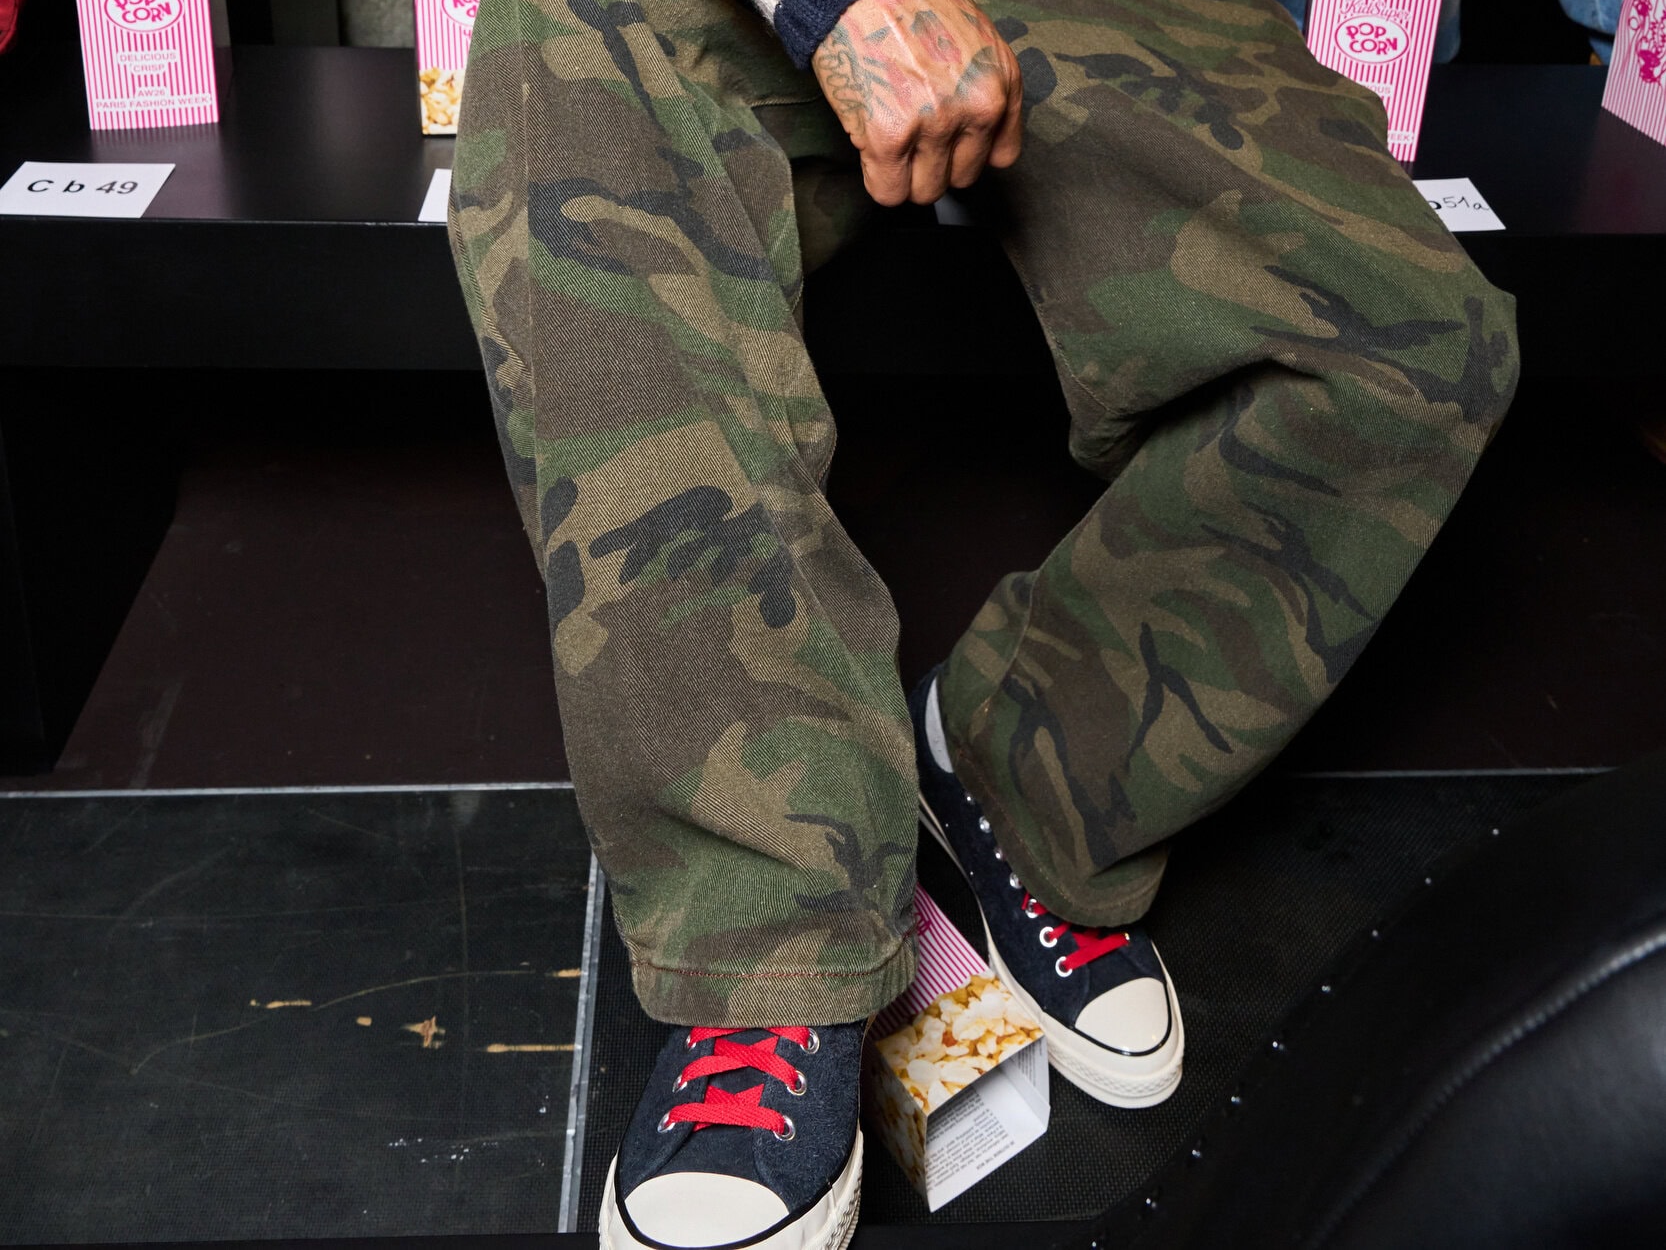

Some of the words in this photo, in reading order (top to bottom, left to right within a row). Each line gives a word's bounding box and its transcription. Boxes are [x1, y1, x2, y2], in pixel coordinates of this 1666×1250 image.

[121, 2, 172, 23] CORN
[1346, 22, 1387, 39] POP
[1349, 37, 1397, 55] CORN
[119, 52, 177, 62] DELICIOUS
[133, 64, 165, 73] CRISP
[137, 89, 166, 98] AW26
[96, 100, 126, 109] PARIS
[129, 98, 175, 108] FASHION
[27, 179, 55, 193] C
[95, 180, 138, 194] 49
